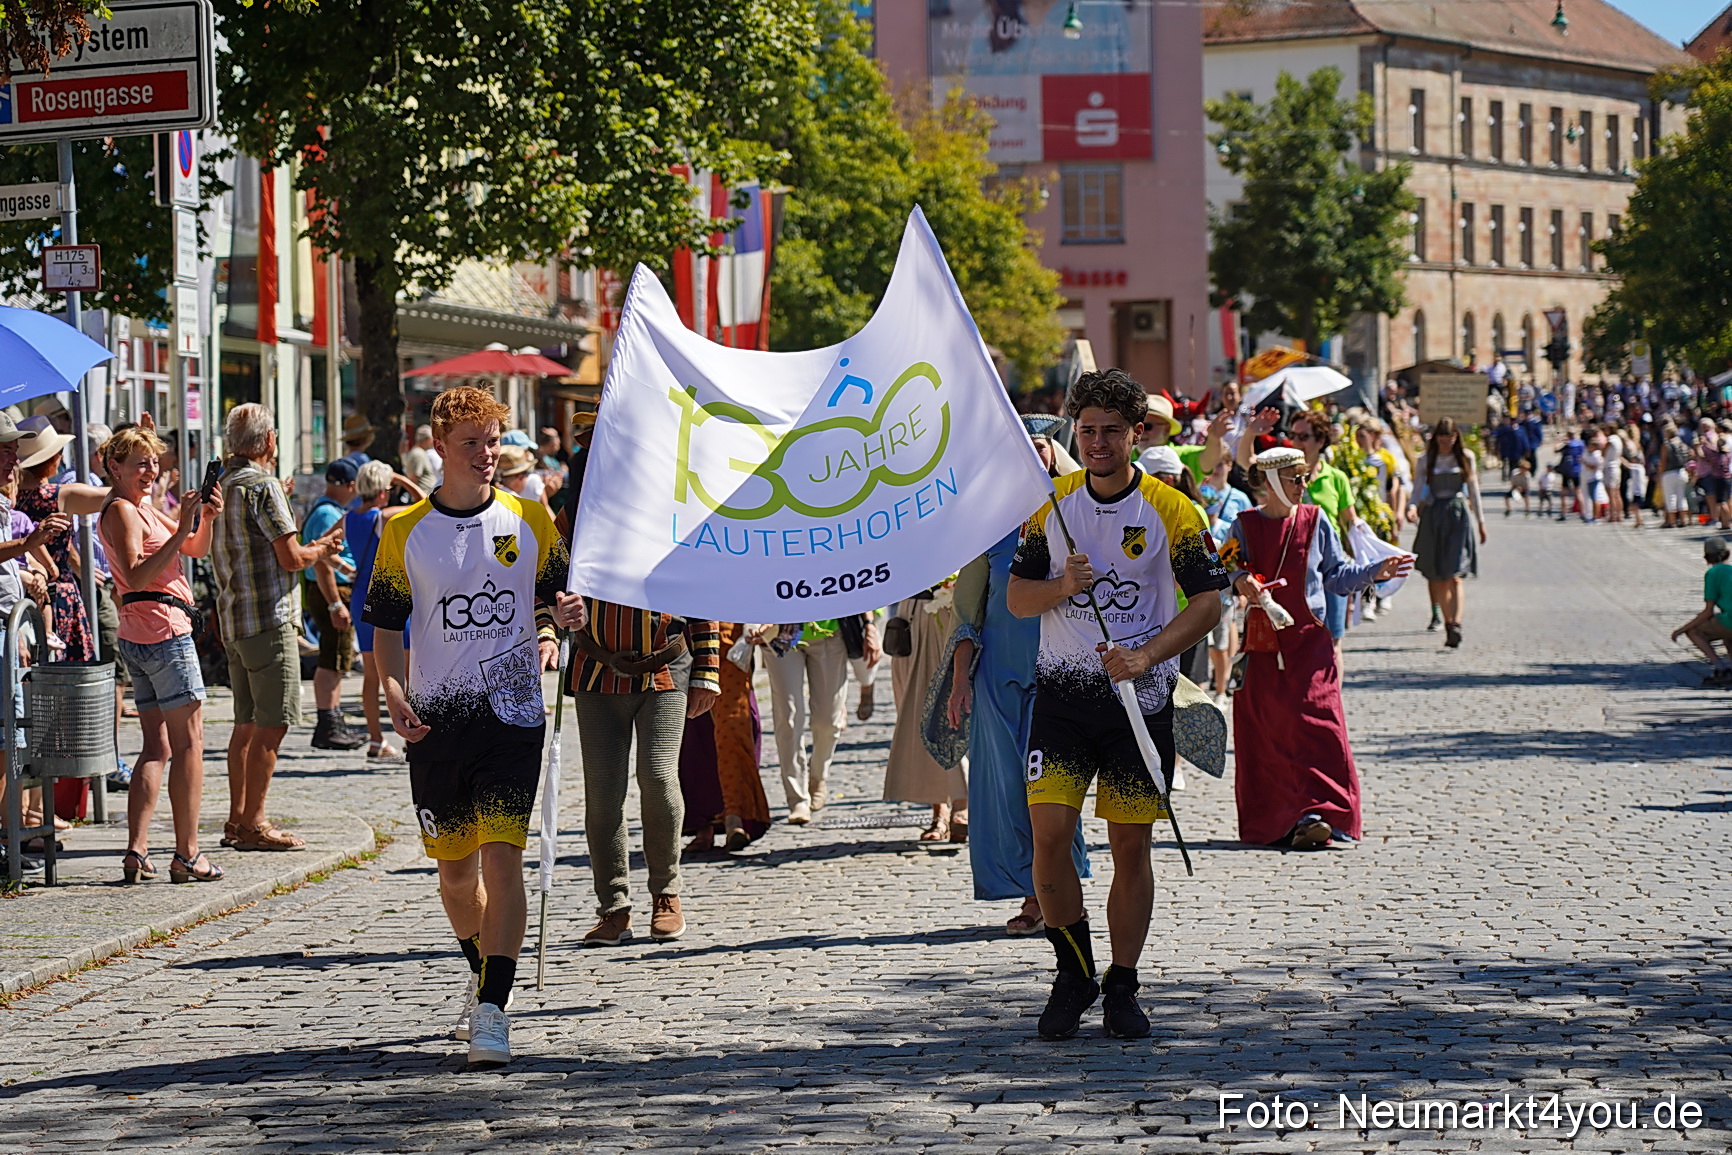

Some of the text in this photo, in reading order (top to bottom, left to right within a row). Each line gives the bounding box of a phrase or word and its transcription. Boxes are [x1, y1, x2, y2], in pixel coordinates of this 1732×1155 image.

[31, 84, 153, 114] Rosengasse
[808, 403, 928, 483] JAHRE
[672, 467, 958, 557] LAUTERHOFEN
[495, 536, 506, 548] SV
[1125, 528, 1136, 539] SV
[776, 562, 891, 600] 06.2025
[1099, 589, 1130, 600] JAHRE
[438, 589, 515, 630] 1300
[476, 602, 511, 615] JAHRE
[443, 626, 513, 643] LAUTERHOFEN
[1027, 749, 1043, 782] 8
